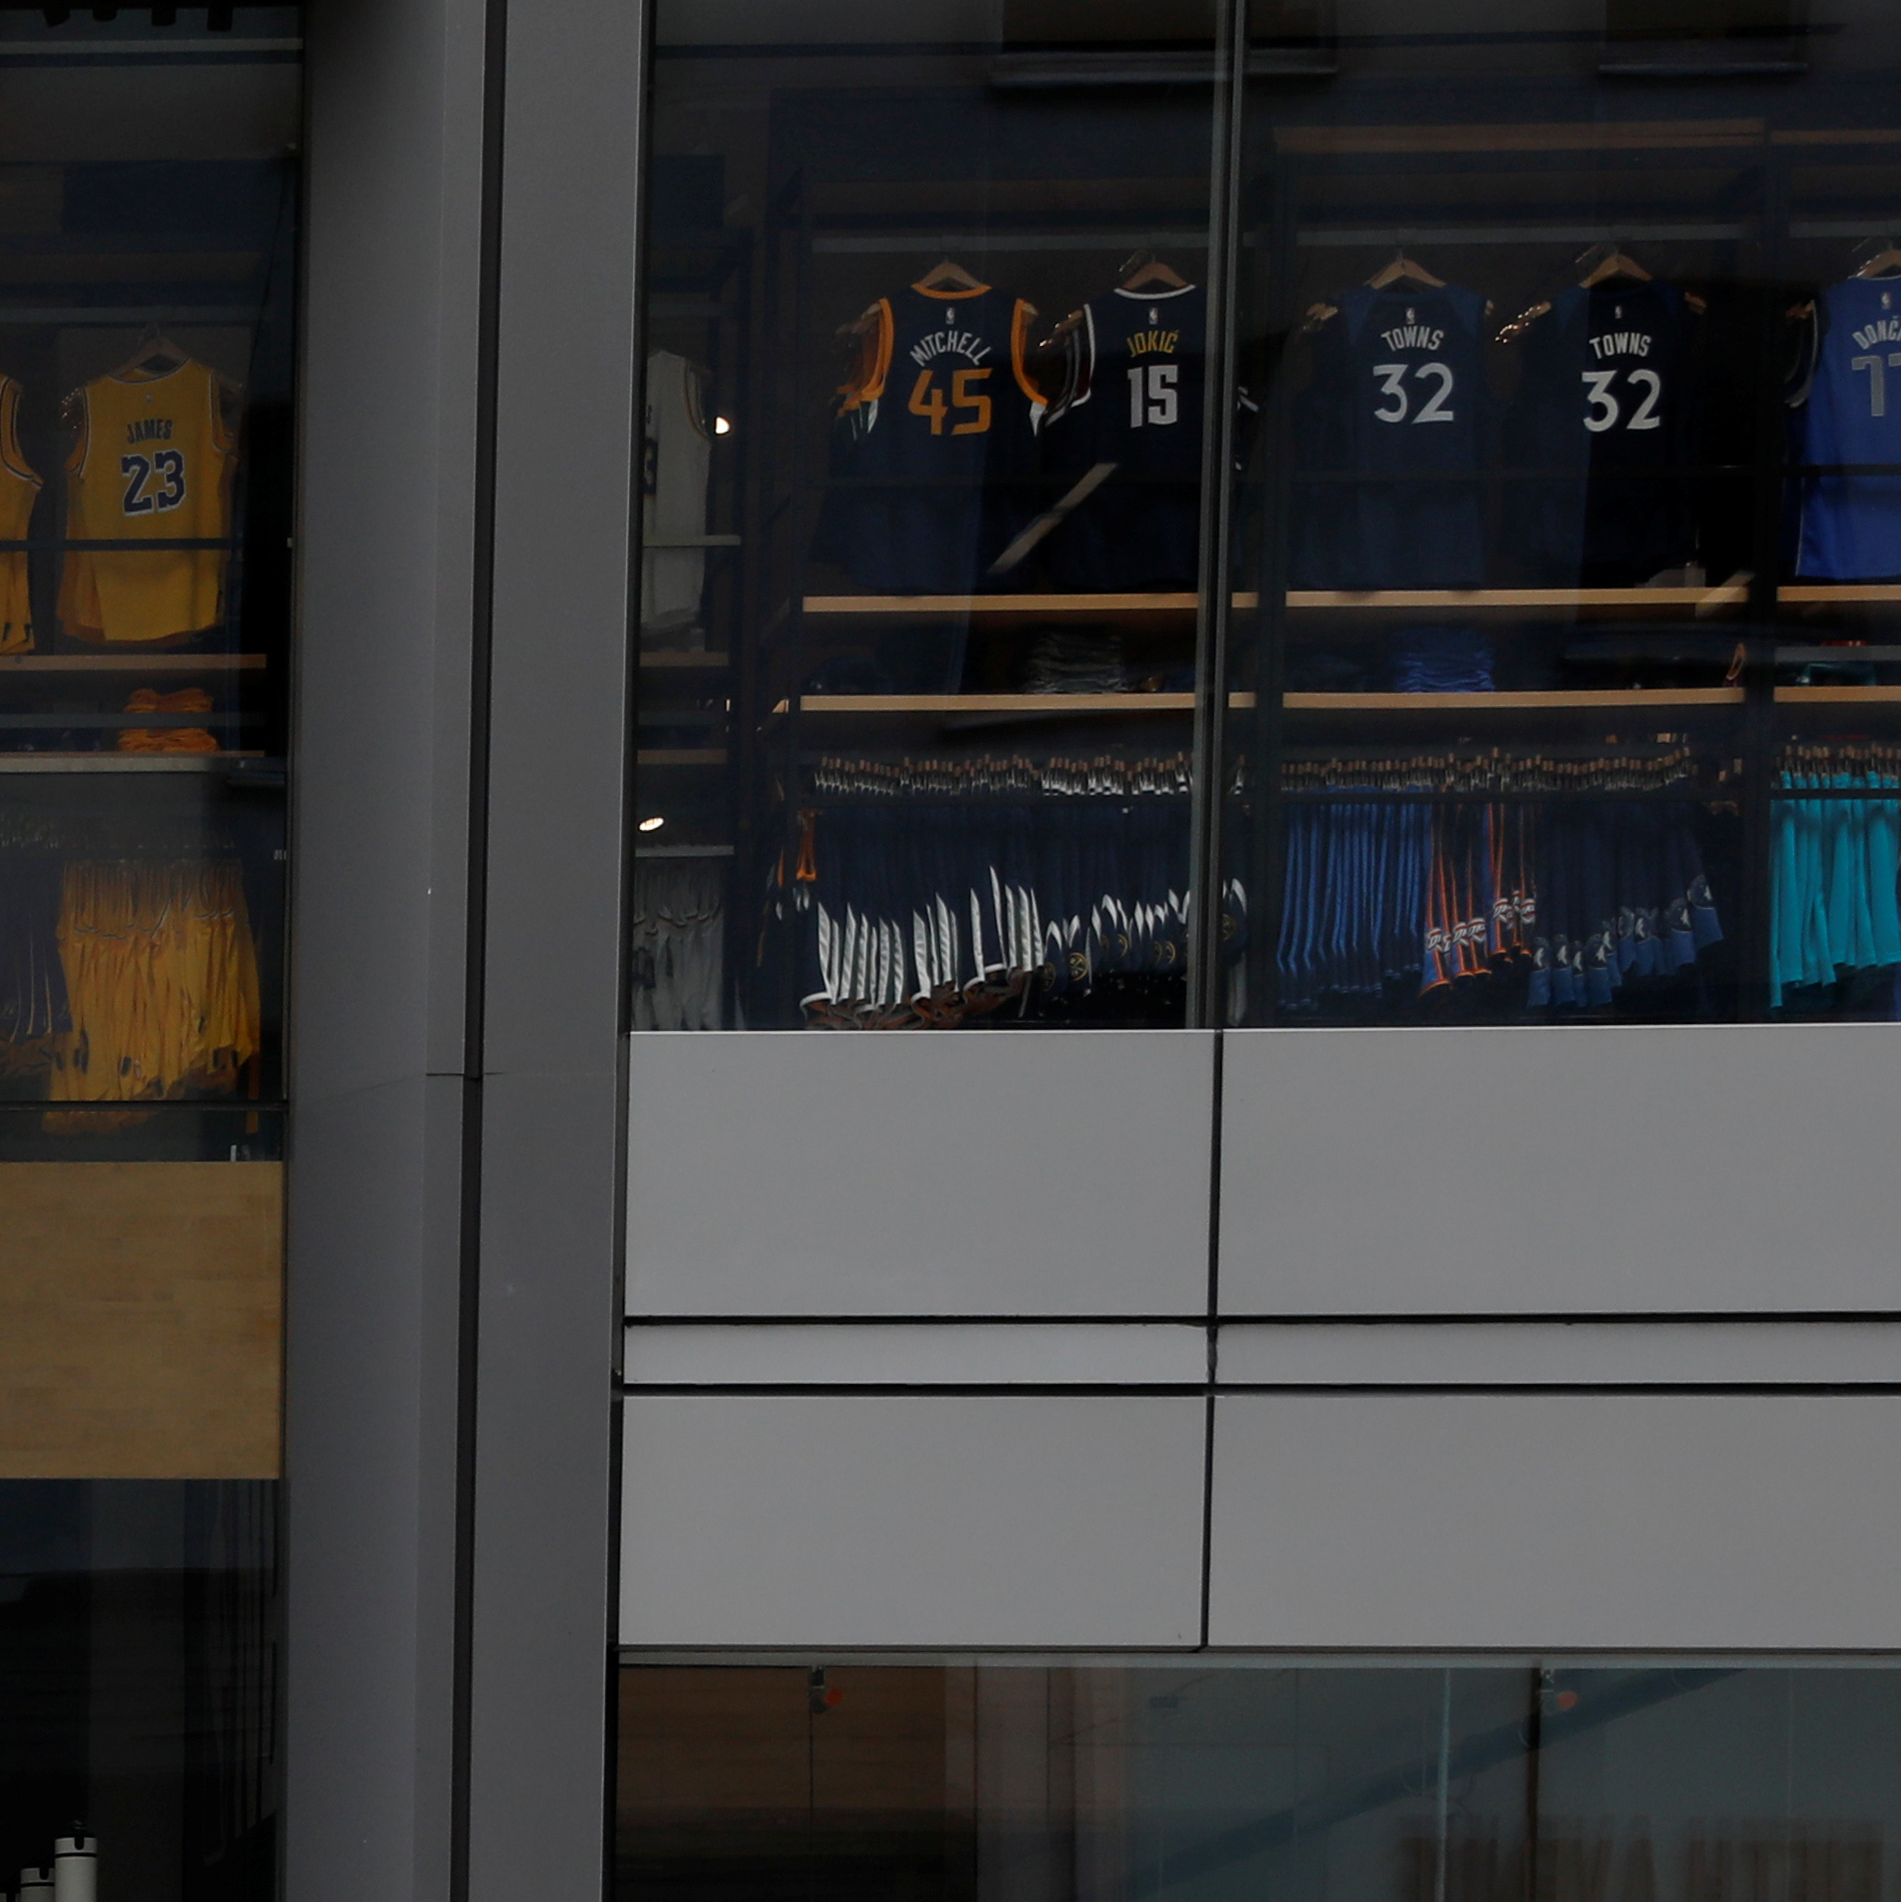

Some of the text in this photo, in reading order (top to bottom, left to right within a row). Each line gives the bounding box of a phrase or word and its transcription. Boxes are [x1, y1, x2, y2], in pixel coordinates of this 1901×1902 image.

[908, 329, 993, 369] MITCHELL
[1381, 324, 1445, 353] TOWNS
[1589, 331, 1652, 360] TOWNS
[907, 366, 993, 436] 45
[1127, 364, 1179, 430] 15
[1373, 362, 1454, 425] 32
[1581, 368, 1661, 433] 32
[126, 418, 173, 444] JAMES
[121, 449, 187, 517] 23
